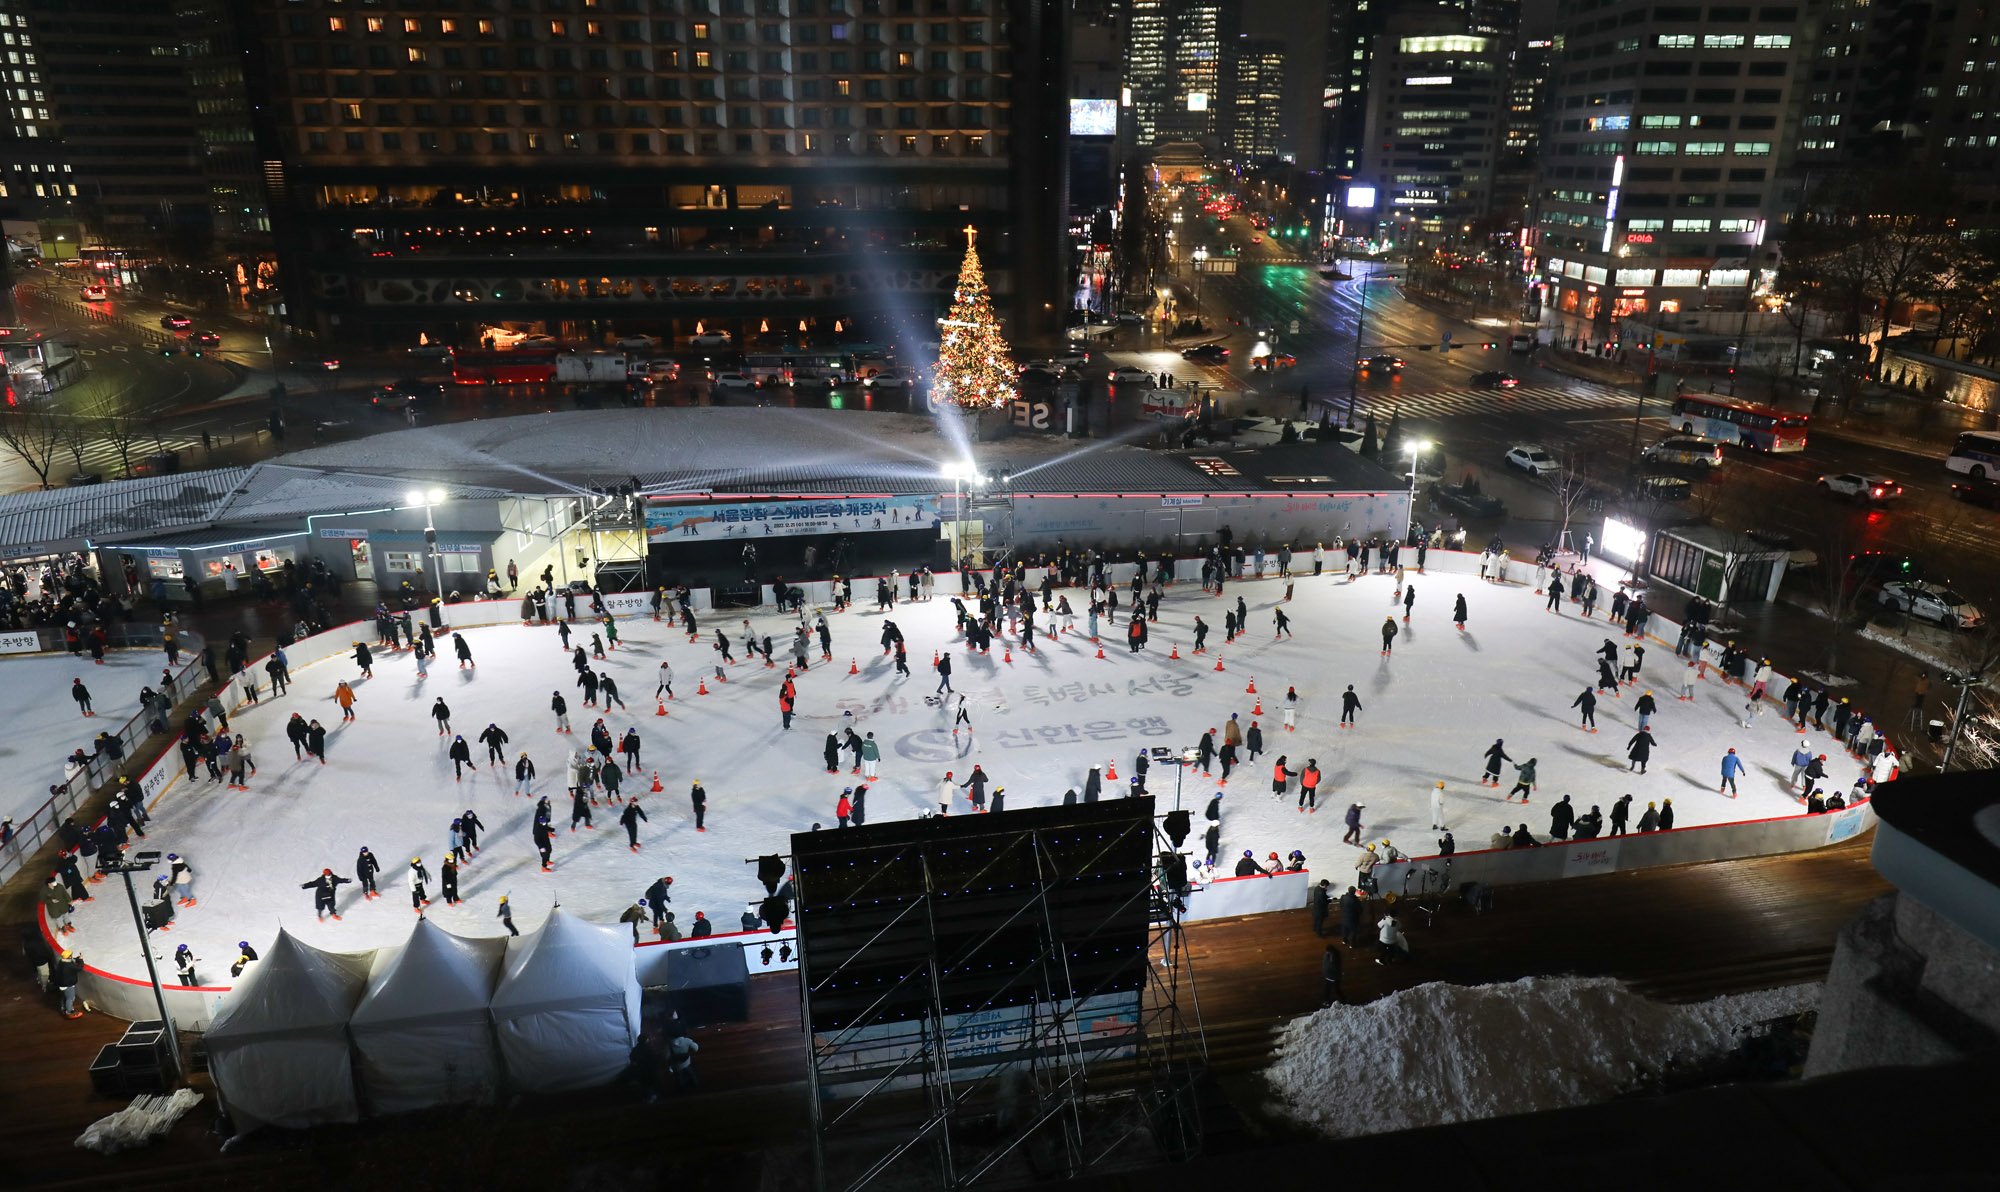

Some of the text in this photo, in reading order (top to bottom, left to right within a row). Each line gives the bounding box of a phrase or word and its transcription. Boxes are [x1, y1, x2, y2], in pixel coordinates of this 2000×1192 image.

[1628, 234, 1653, 243] 다이소
[712, 502, 887, 523] 서울광장 스케이트장 개장식
[229, 543, 246, 552] 대여
[0, 637, 35, 648] 주방향
[1023, 681, 1116, 707] 특별시
[1128, 671, 1199, 698] 서울
[996, 715, 1172, 750] 신한은행
